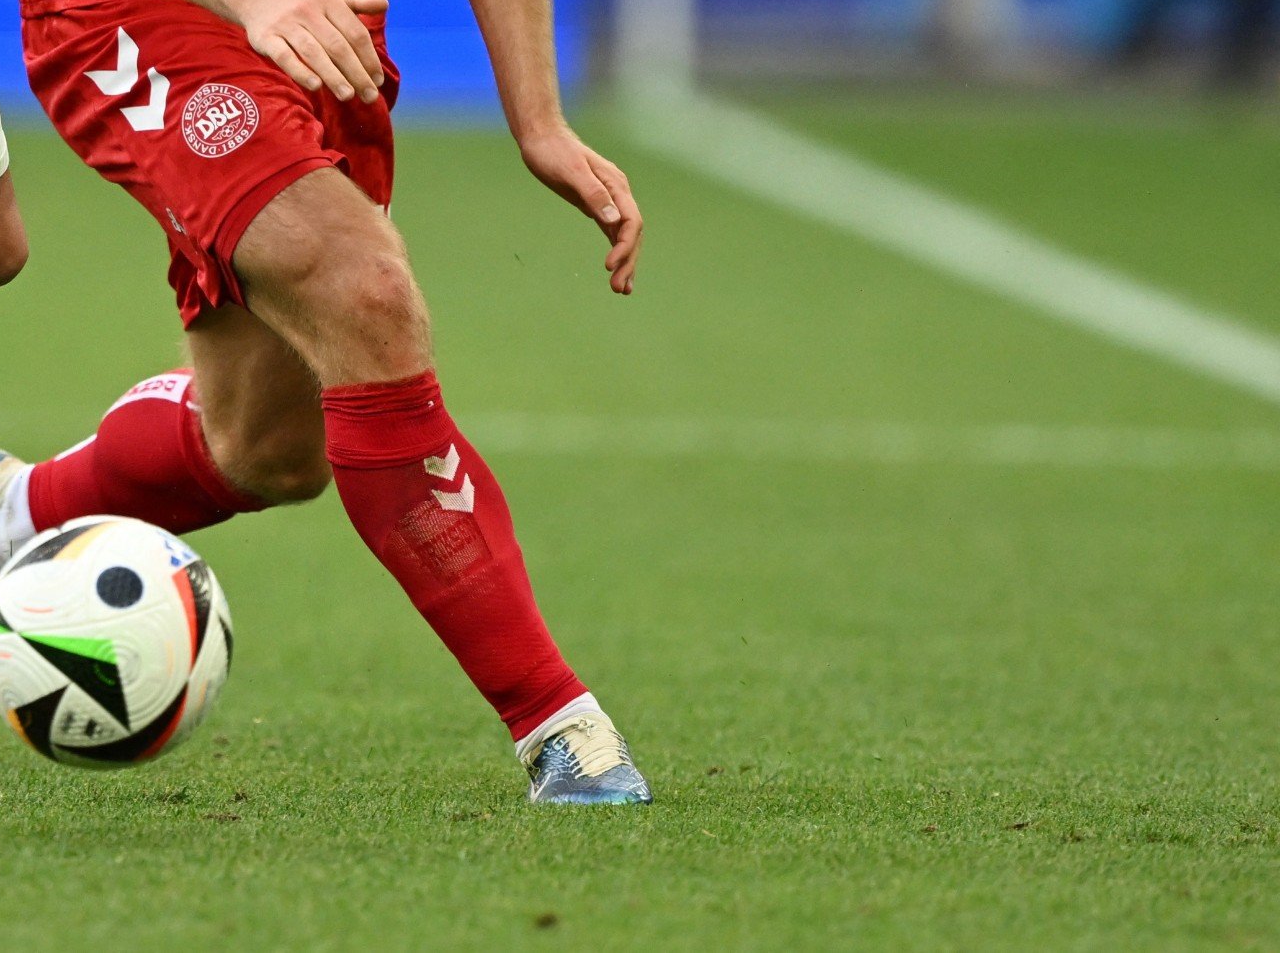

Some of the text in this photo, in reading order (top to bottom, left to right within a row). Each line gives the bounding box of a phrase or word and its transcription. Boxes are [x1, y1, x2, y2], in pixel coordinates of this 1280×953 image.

[195, 99, 242, 139] DBU
[185, 125, 217, 155] DANSK
[222, 129, 249, 152] 1889
